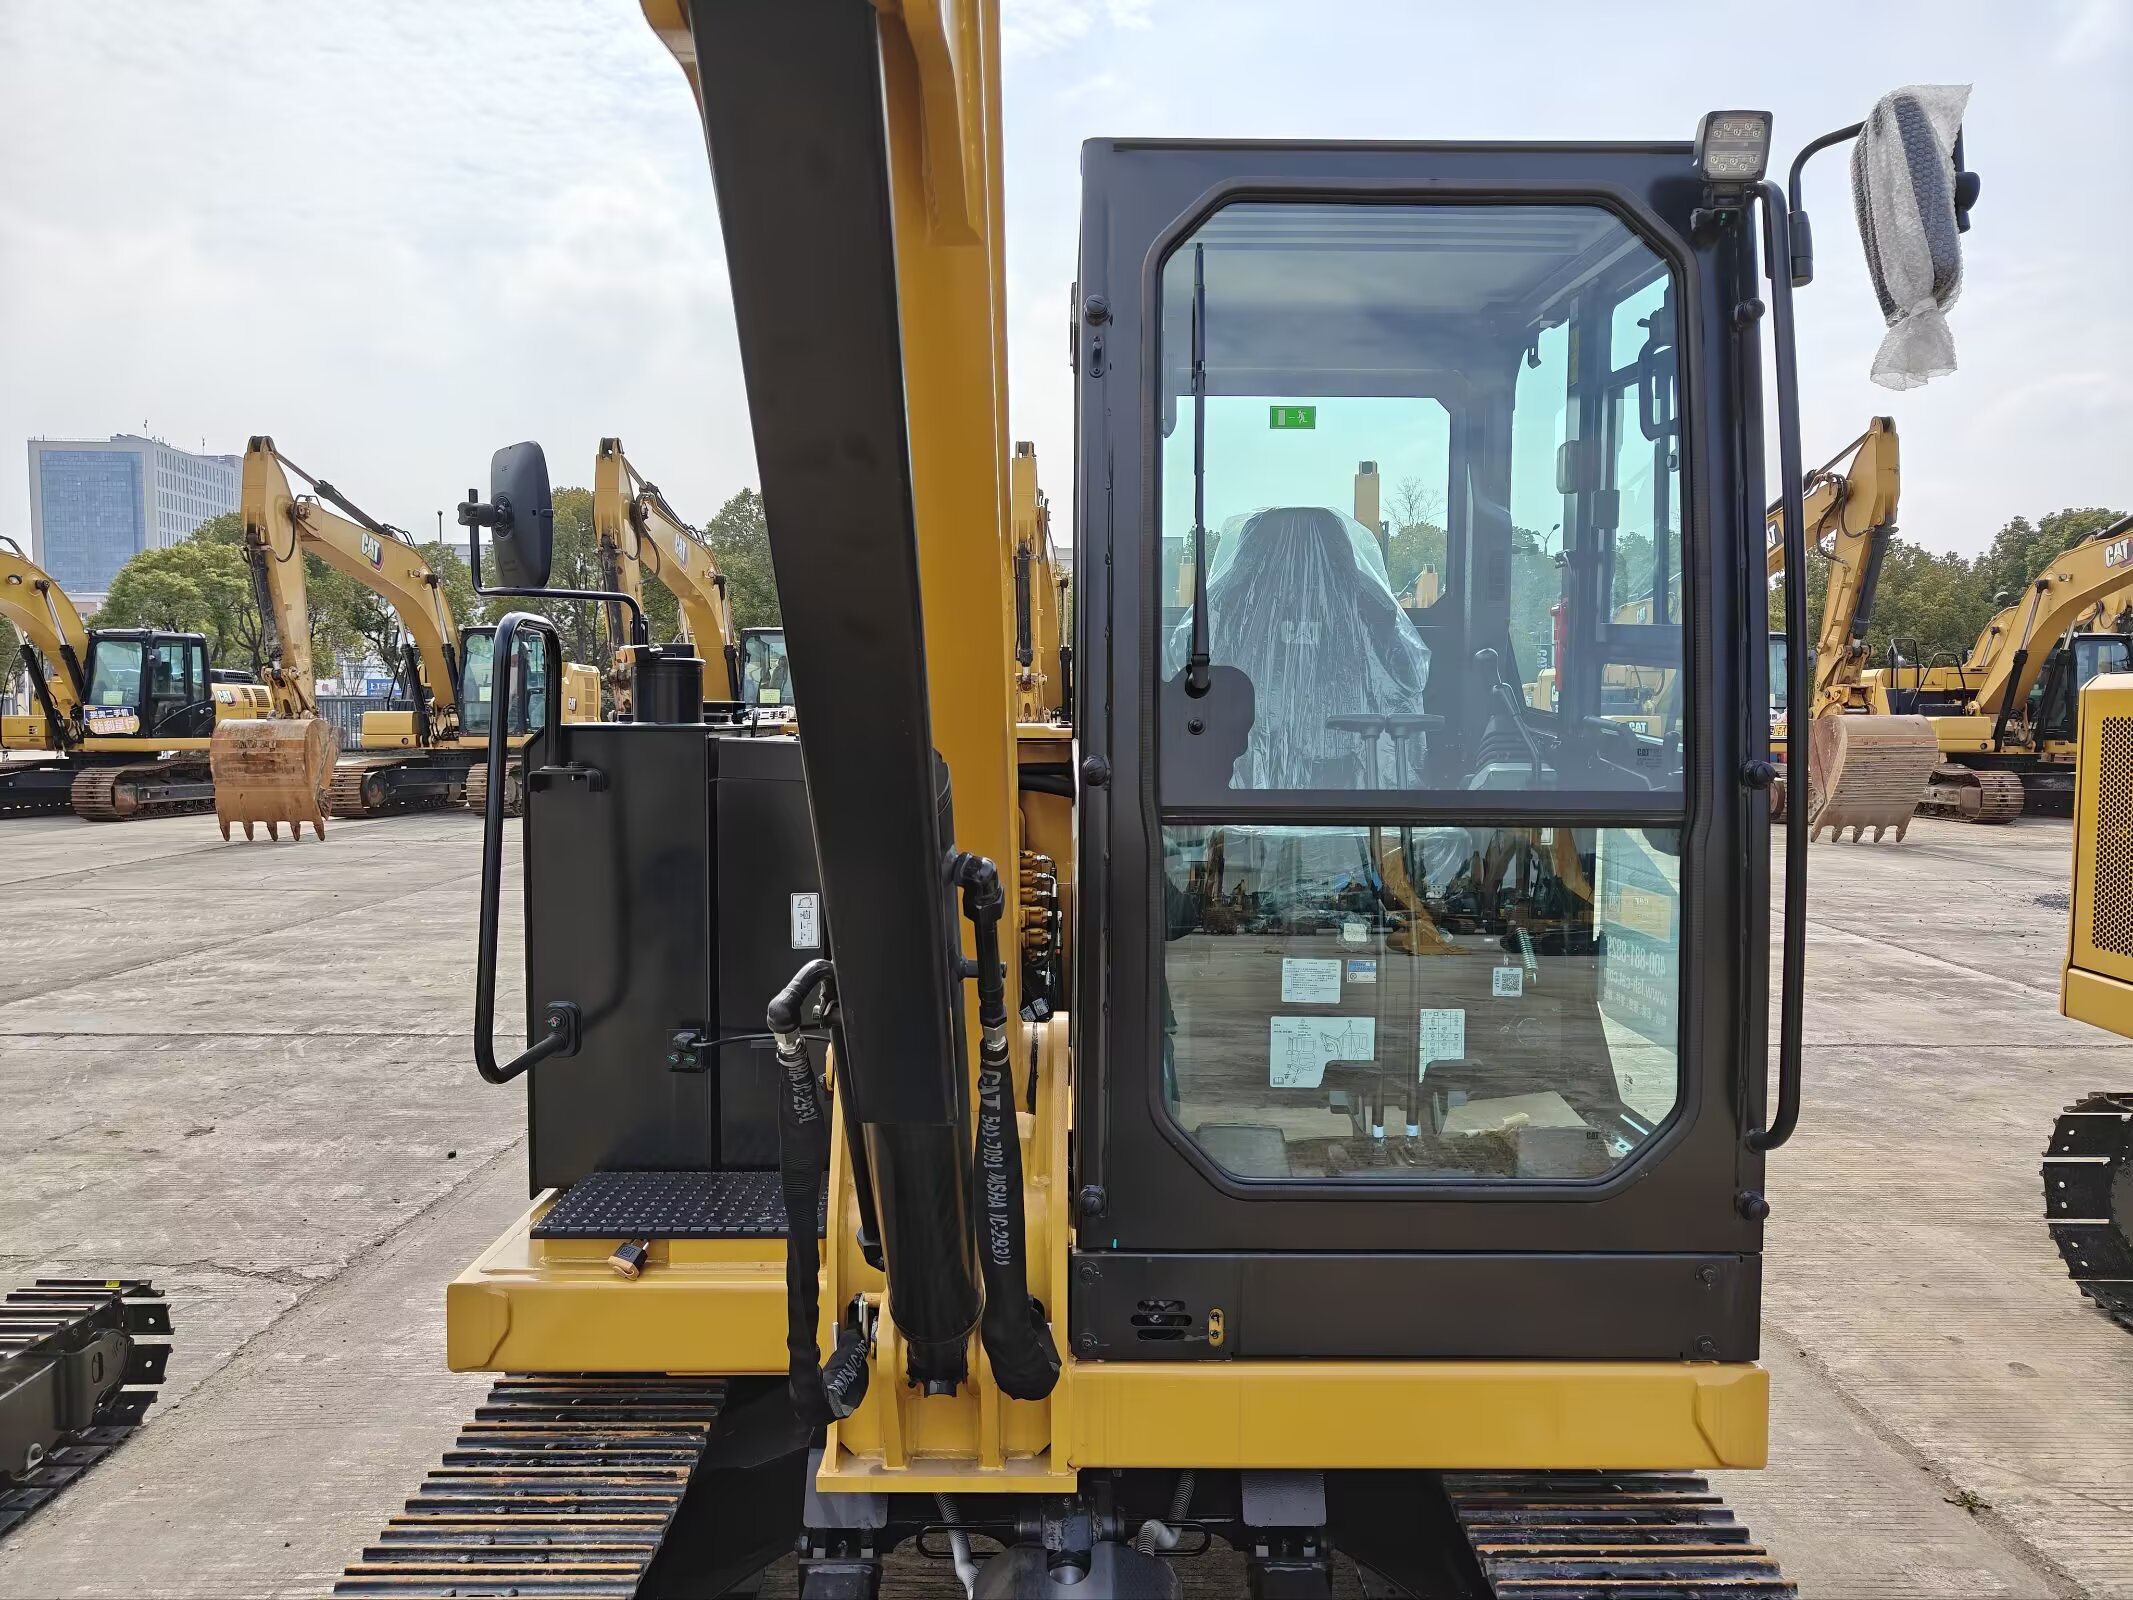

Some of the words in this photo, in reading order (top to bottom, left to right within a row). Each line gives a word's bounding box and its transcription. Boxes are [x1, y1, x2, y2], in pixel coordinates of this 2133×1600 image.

[362, 532, 380, 563] CAT
[674, 532, 687, 562] CAT
[2105, 539, 2129, 567] CAT
[981, 1068, 1002, 1110] CAT
[987, 1171, 1007, 1208] MSHA
